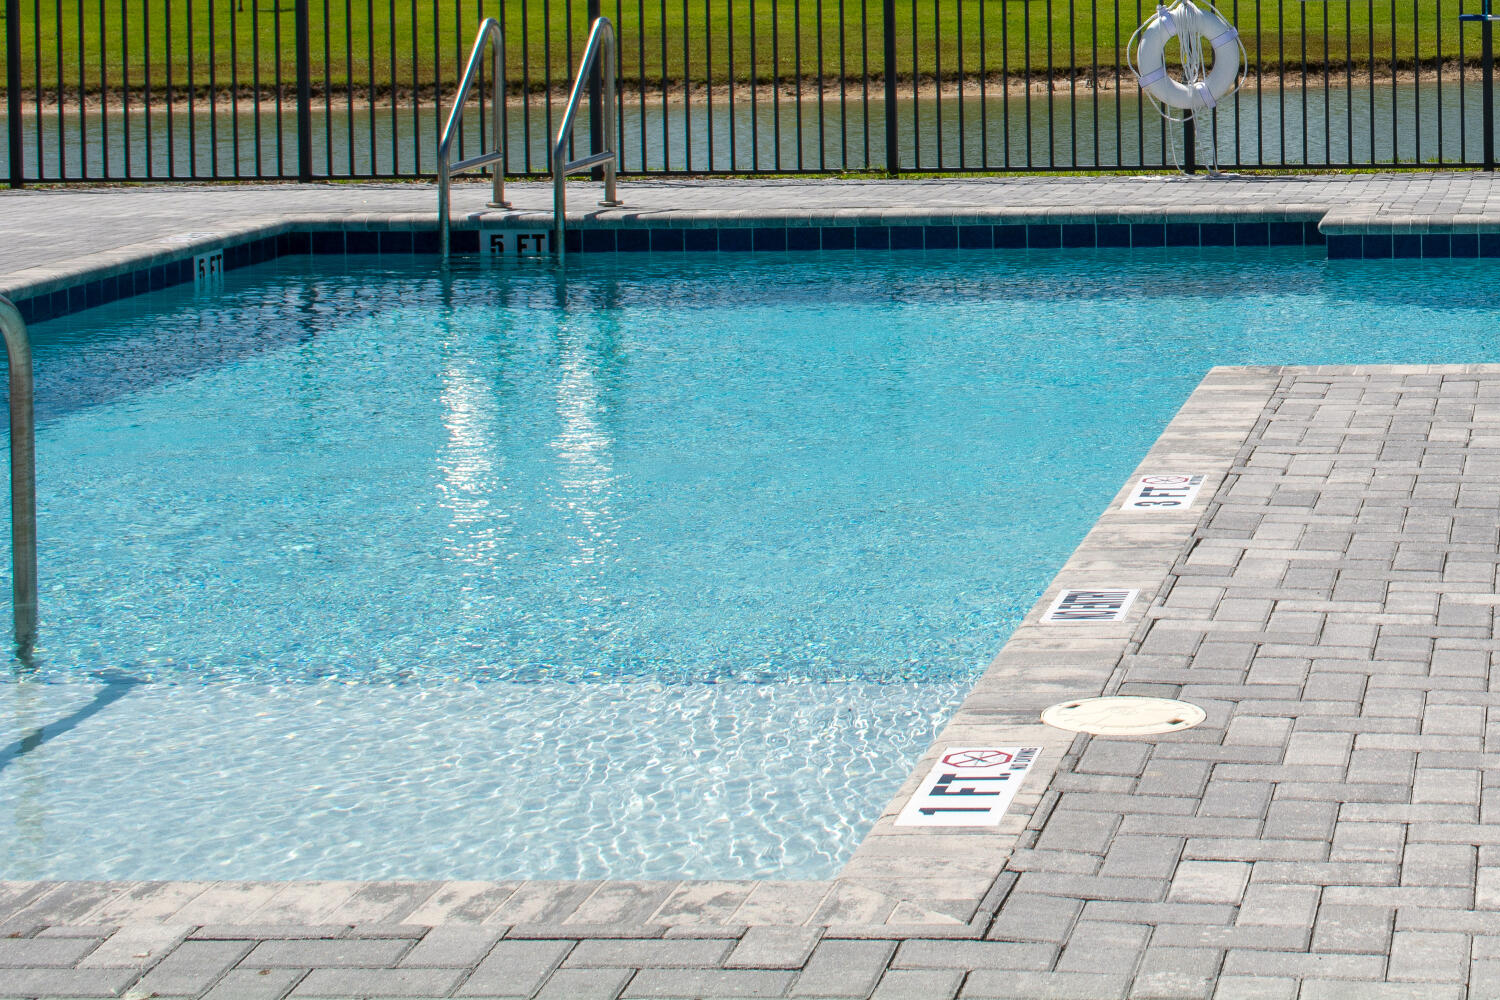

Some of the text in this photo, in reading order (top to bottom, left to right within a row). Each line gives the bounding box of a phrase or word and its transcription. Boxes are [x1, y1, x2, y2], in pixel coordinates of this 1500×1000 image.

[490, 234, 545, 253] 5 FT
[199, 254, 222, 279] 5 FT
[1050, 590, 1130, 619] NO ENTRY
[918, 807, 991, 816] 1
